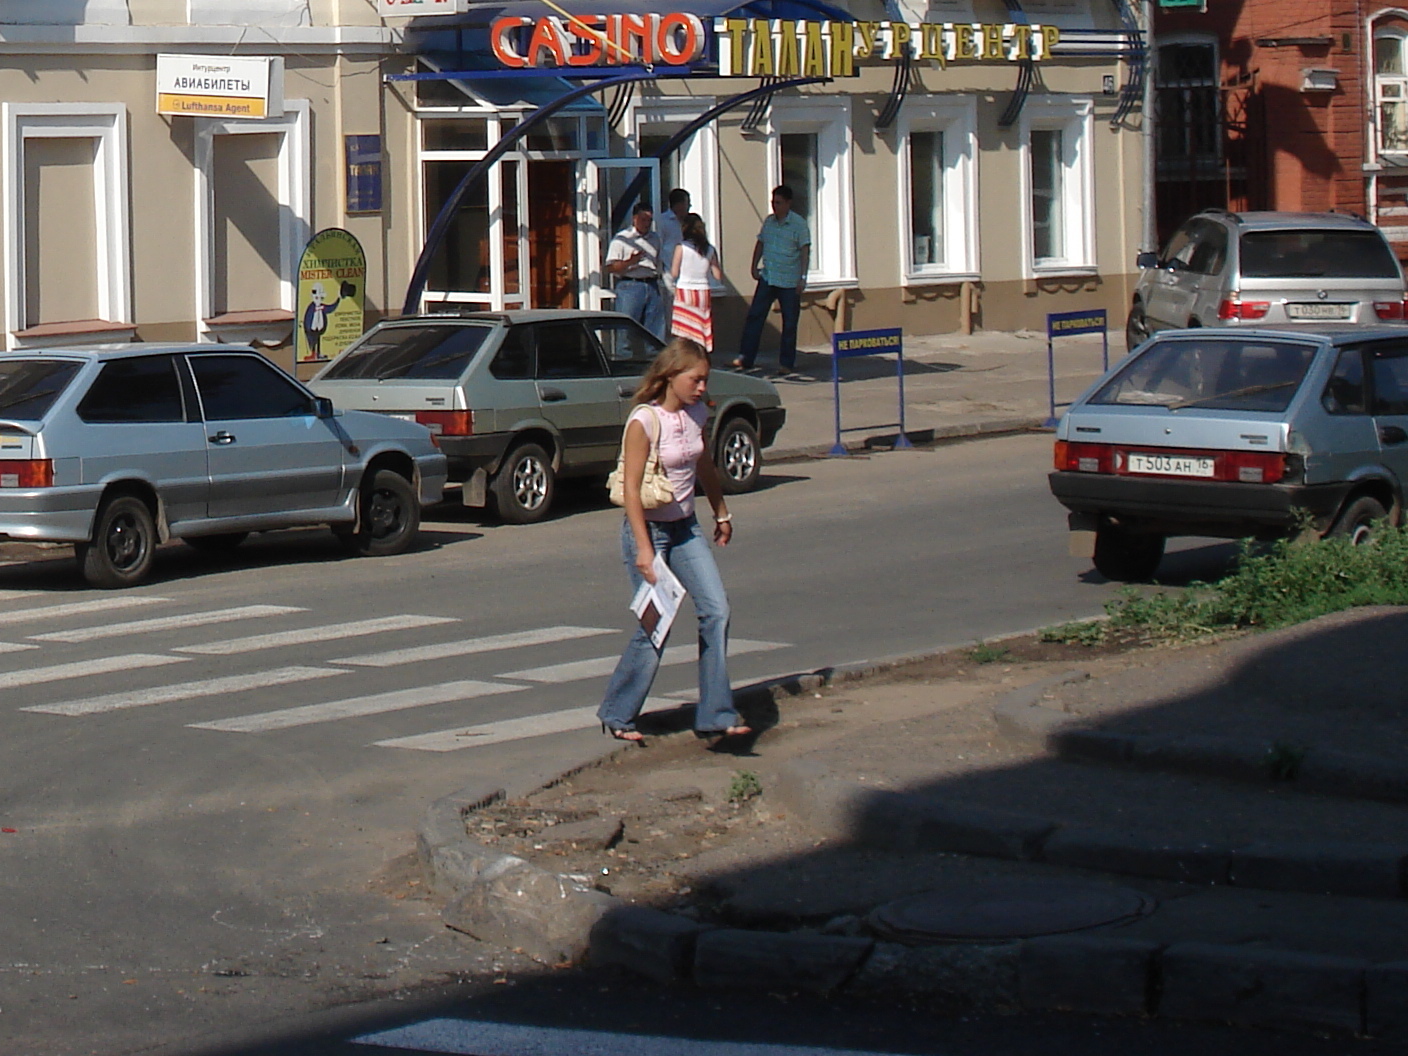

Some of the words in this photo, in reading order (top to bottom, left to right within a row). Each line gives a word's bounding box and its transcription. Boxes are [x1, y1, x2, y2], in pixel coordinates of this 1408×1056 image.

[491, 13, 698, 67] CASINO
[724, 17, 854, 77] ТАЛАН
[852, 21, 1060, 71] УРЦЕНТР
[192, 64, 231, 74] Интурцентр
[174, 77, 250, 92] АВИАБИЛЕТЫ
[182, 101, 223, 112] Lufthansa
[225, 103, 251, 115] Agent
[302, 256, 364, 269] ХИМЧИСТКА
[300, 268, 332, 280] MISTER
[335, 266, 364, 279] CLEAN
[838, 339, 848, 350] НЕ
